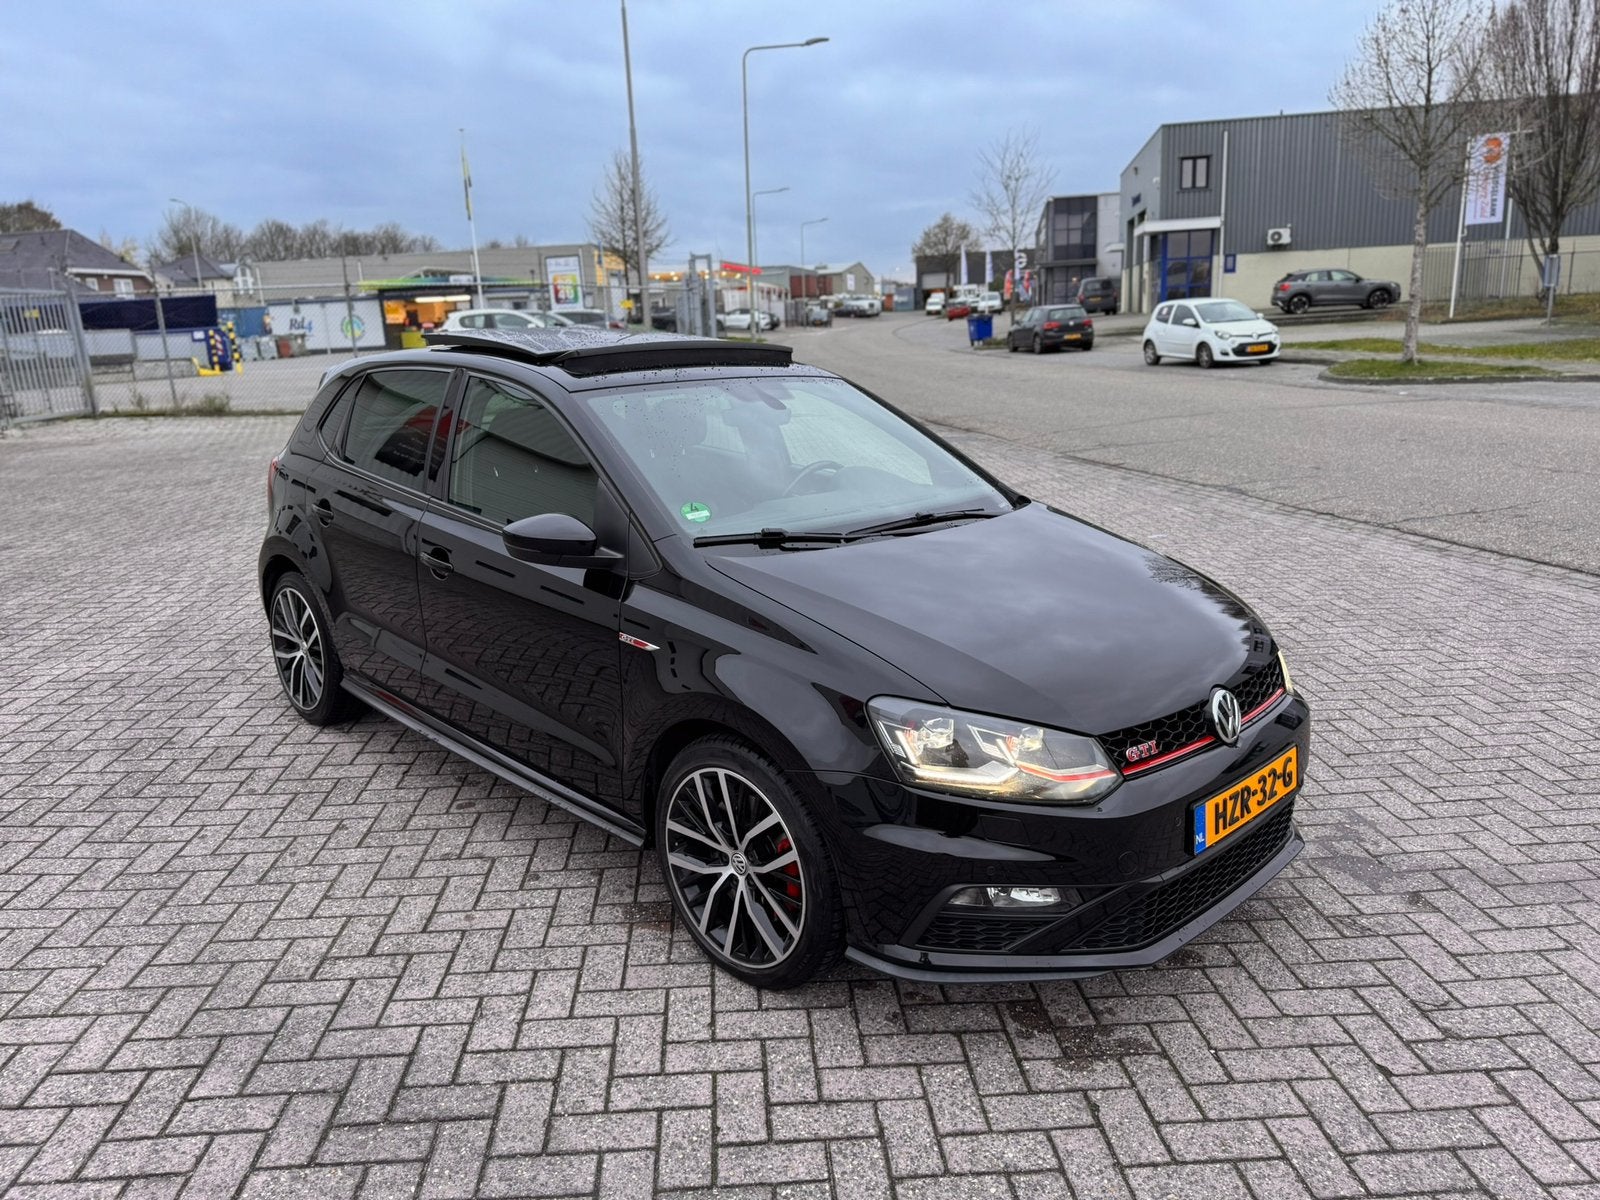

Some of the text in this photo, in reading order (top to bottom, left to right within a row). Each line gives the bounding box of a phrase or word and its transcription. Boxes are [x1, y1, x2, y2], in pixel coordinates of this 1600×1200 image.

[690, 503, 699, 512] 4
[1126, 739, 1159, 762] GTI
[1214, 757, 1292, 834] HZR-32-G
[1195, 832, 1205, 845] NL
